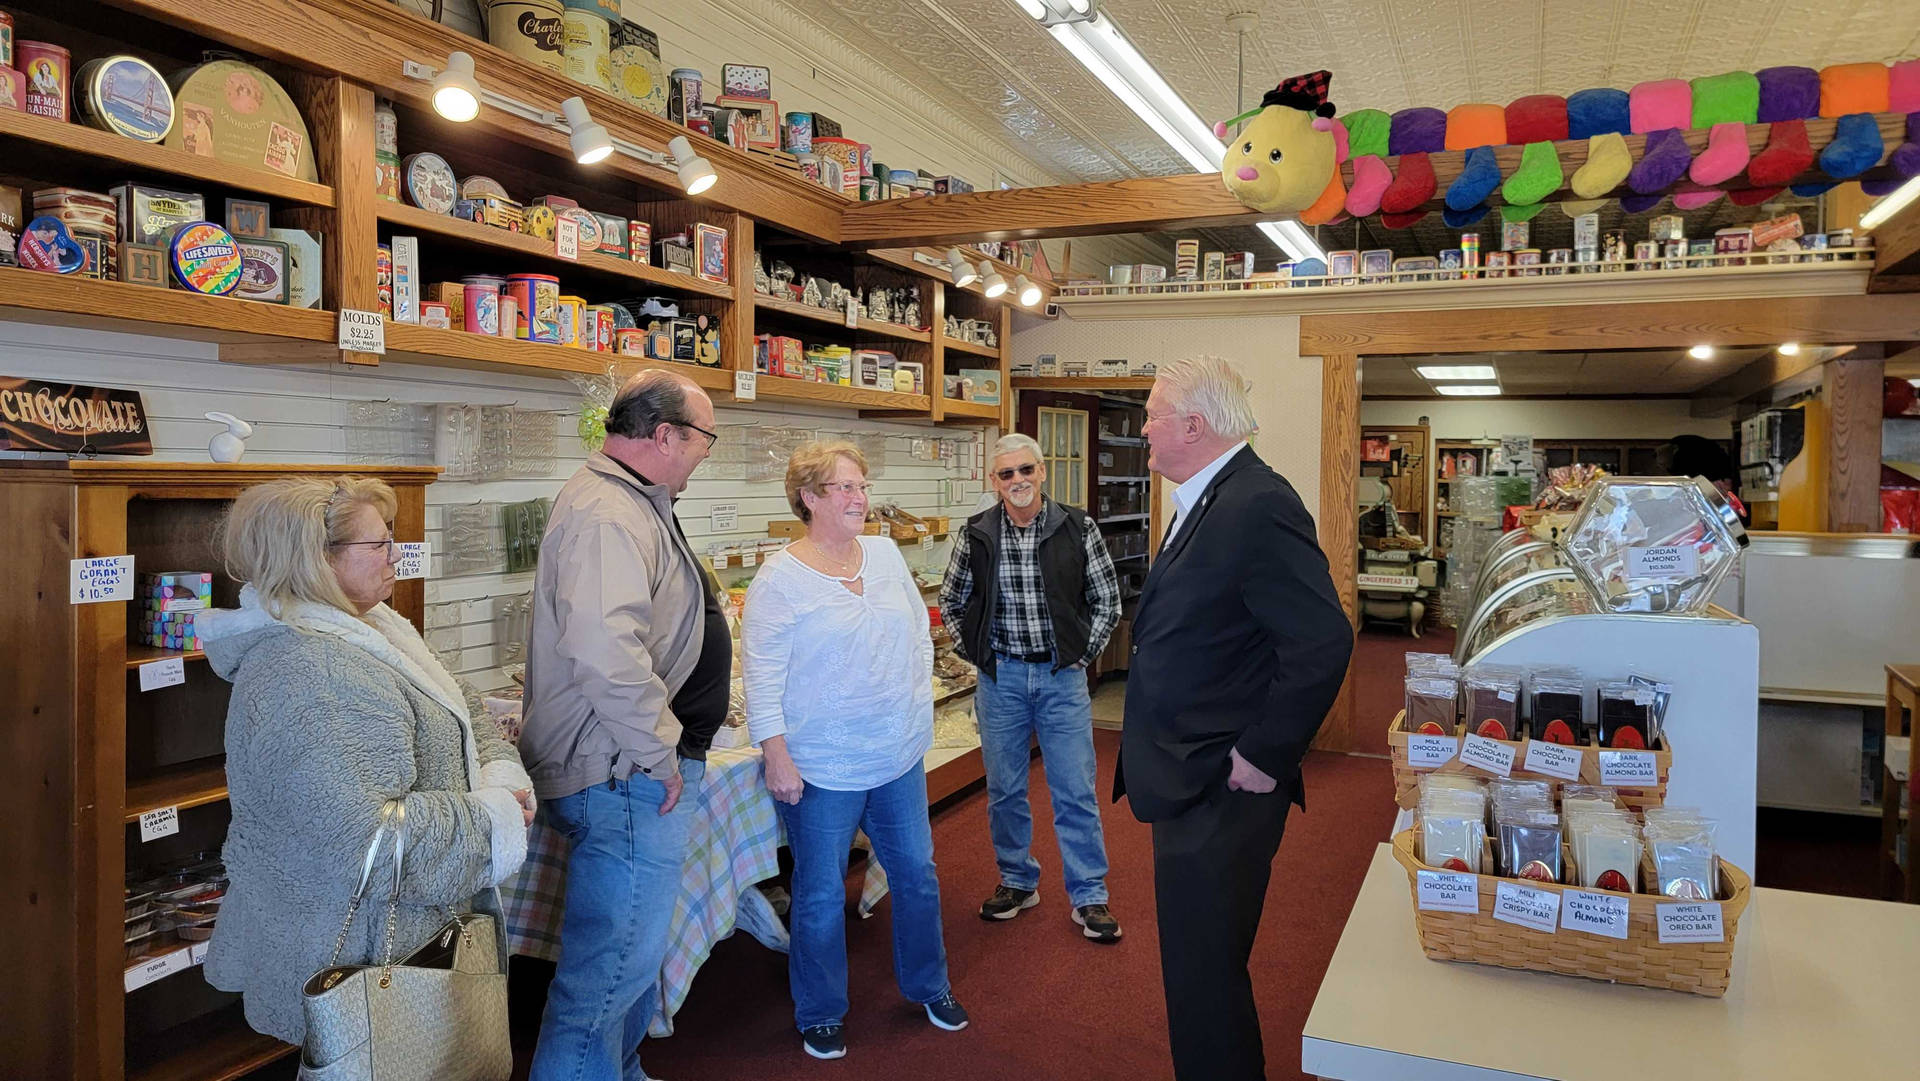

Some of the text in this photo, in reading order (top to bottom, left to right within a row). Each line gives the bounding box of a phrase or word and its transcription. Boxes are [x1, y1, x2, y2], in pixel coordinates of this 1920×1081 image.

[523, 18, 563, 34] Charle
[27, 94, 63, 108] UN-MAI
[27, 105, 63, 119] RAISINS
[562, 223, 574, 233] NOT
[560, 246, 575, 255] SALE
[343, 311, 381, 326] MOLDS
[350, 327, 374, 339] $2.25
[0, 389, 140, 431] CHOCOLATE
[402, 551, 425, 559] ORANT
[1645, 548, 1677, 556] JORDAN
[85, 557, 120, 569] LARGE
[1642, 555, 1681, 563] ALMONDS
[80, 567, 127, 581] GORANT
[91, 577, 120, 587] EGGS
[1412, 744, 1453, 753] CHOCOLATE
[1483, 740, 1498, 749] MILK
[1545, 745, 1564, 754] DARK
[1468, 742, 1510, 760] CHOCOLATE
[1532, 749, 1575, 763] CHOCOLATE
[1465, 748, 1494, 762] ALMOND
[1495, 758, 1510, 767] BAR
[1545, 759, 1559, 767] BAR
[143, 808, 173, 822] SEA SALT
[144, 814, 176, 828] CARAMEL
[1424, 882, 1473, 893] CHOCOLATE
[1440, 892, 1457, 900] BAR
[1579, 893, 1611, 904] WHITE
[1502, 894, 1553, 912] CHOCOLATE
[1569, 901, 1627, 916] CHOCOLATE
[1676, 905, 1703, 913] WHITE
[1503, 902, 1531, 915] CRISPY
[1533, 909, 1550, 919] BAR
[1574, 911, 1615, 926] ALMOND
[147, 961, 167, 973] FUDGE
